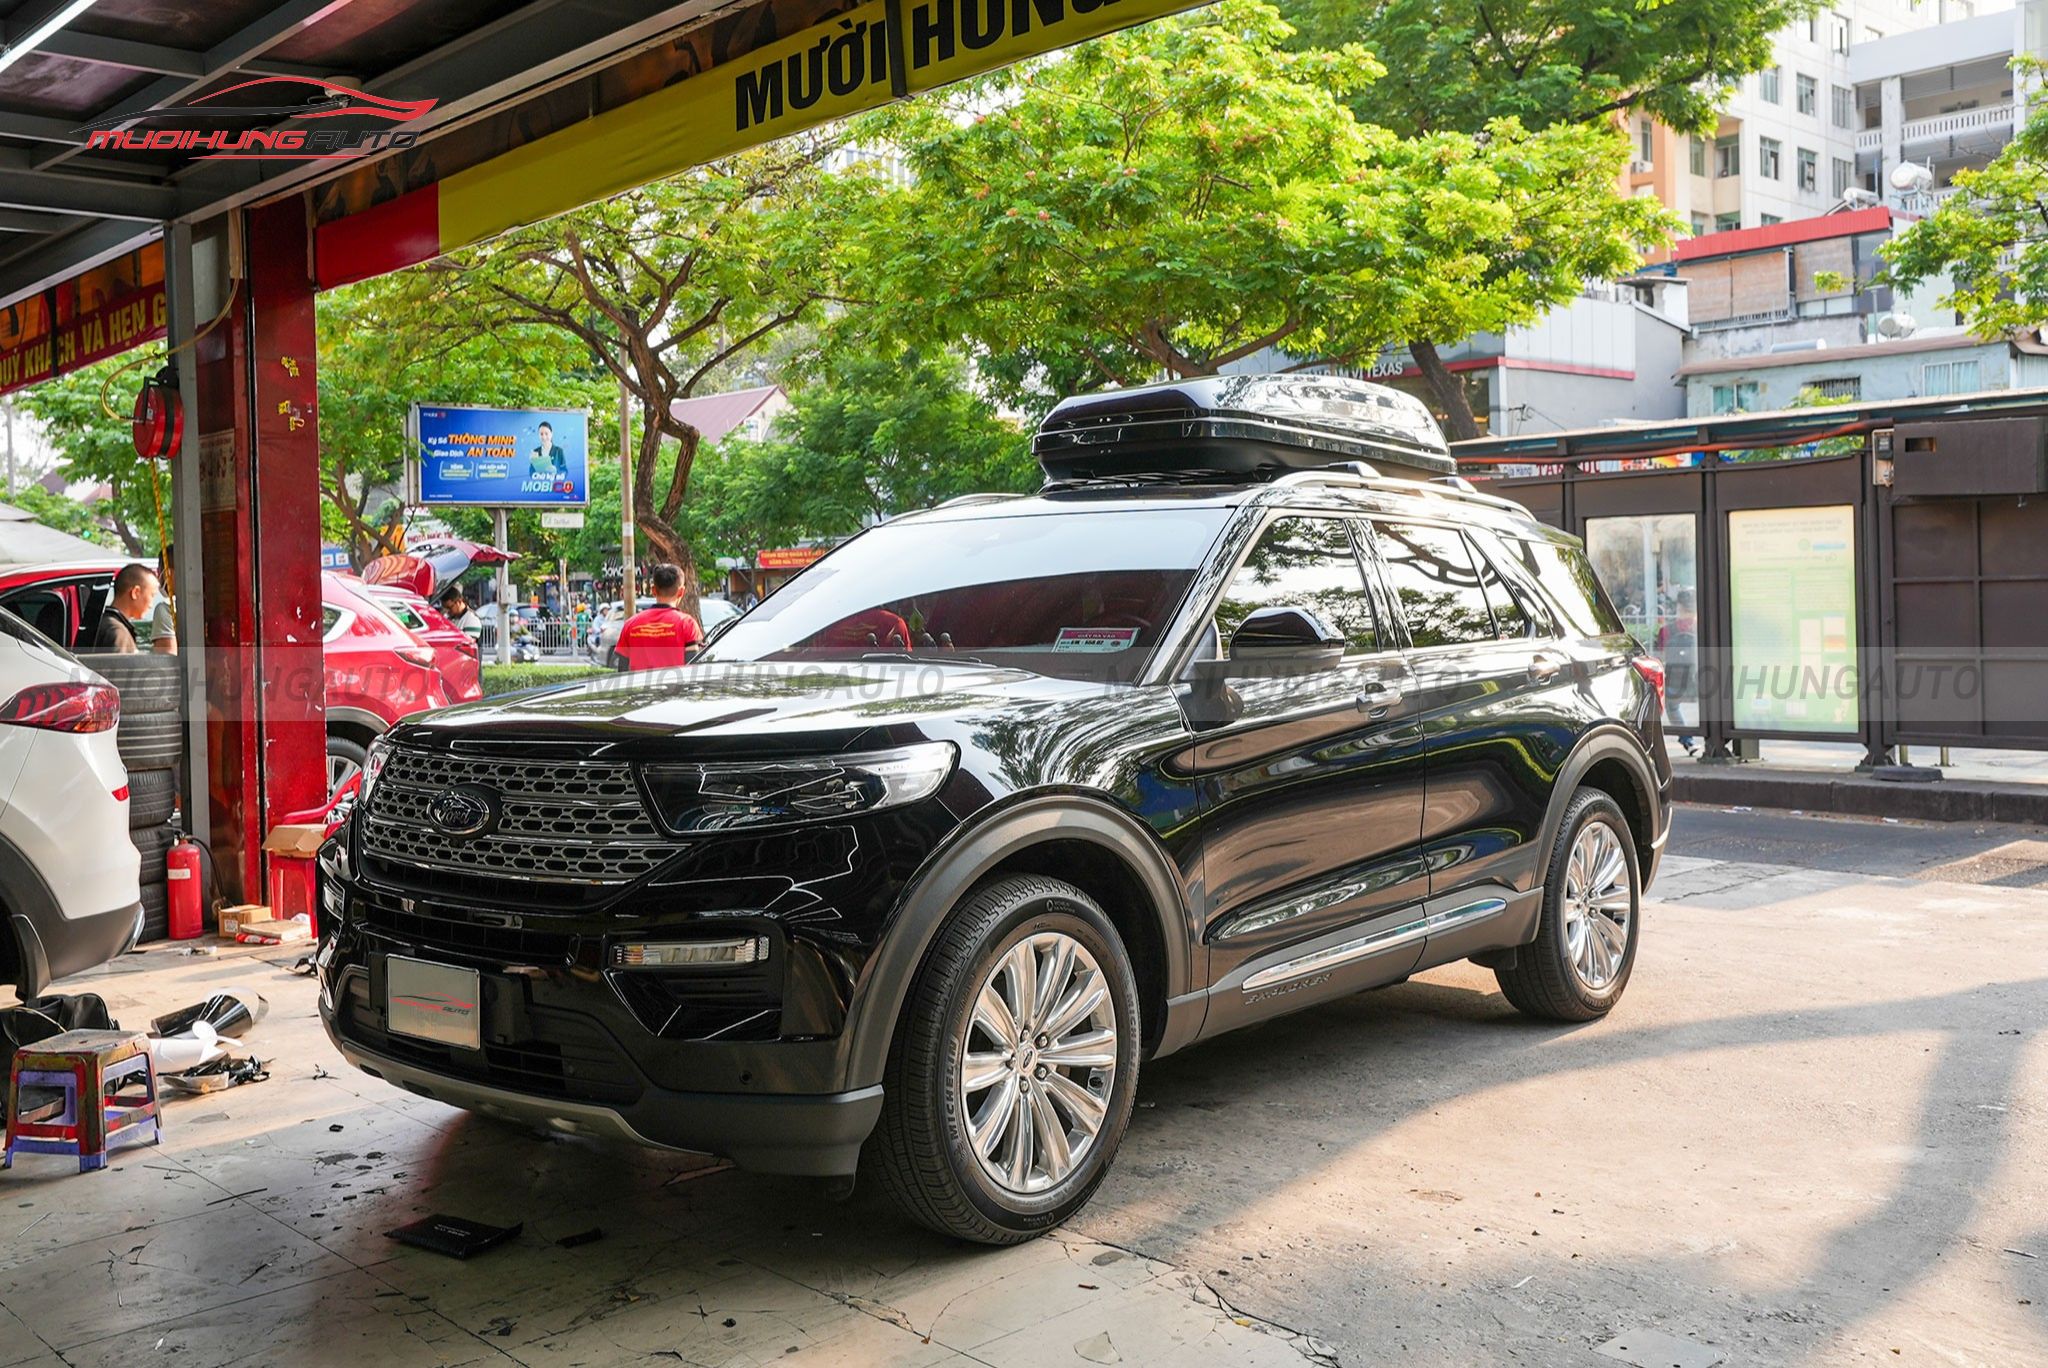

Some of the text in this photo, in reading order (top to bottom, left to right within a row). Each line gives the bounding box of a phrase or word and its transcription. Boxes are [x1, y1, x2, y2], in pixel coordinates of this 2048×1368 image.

[736, 18, 887, 132] MƯỜI
[82, 312, 104, 355] VÀ
[109, 299, 146, 347] HẸN
[1366, 361, 1403, 378] TEXAS
[448, 432, 486, 444] THÔNG
[487, 434, 517, 445] MINH
[486, 445, 516, 457] TOÀN
[944, 1040, 959, 1141] MICHELIN
